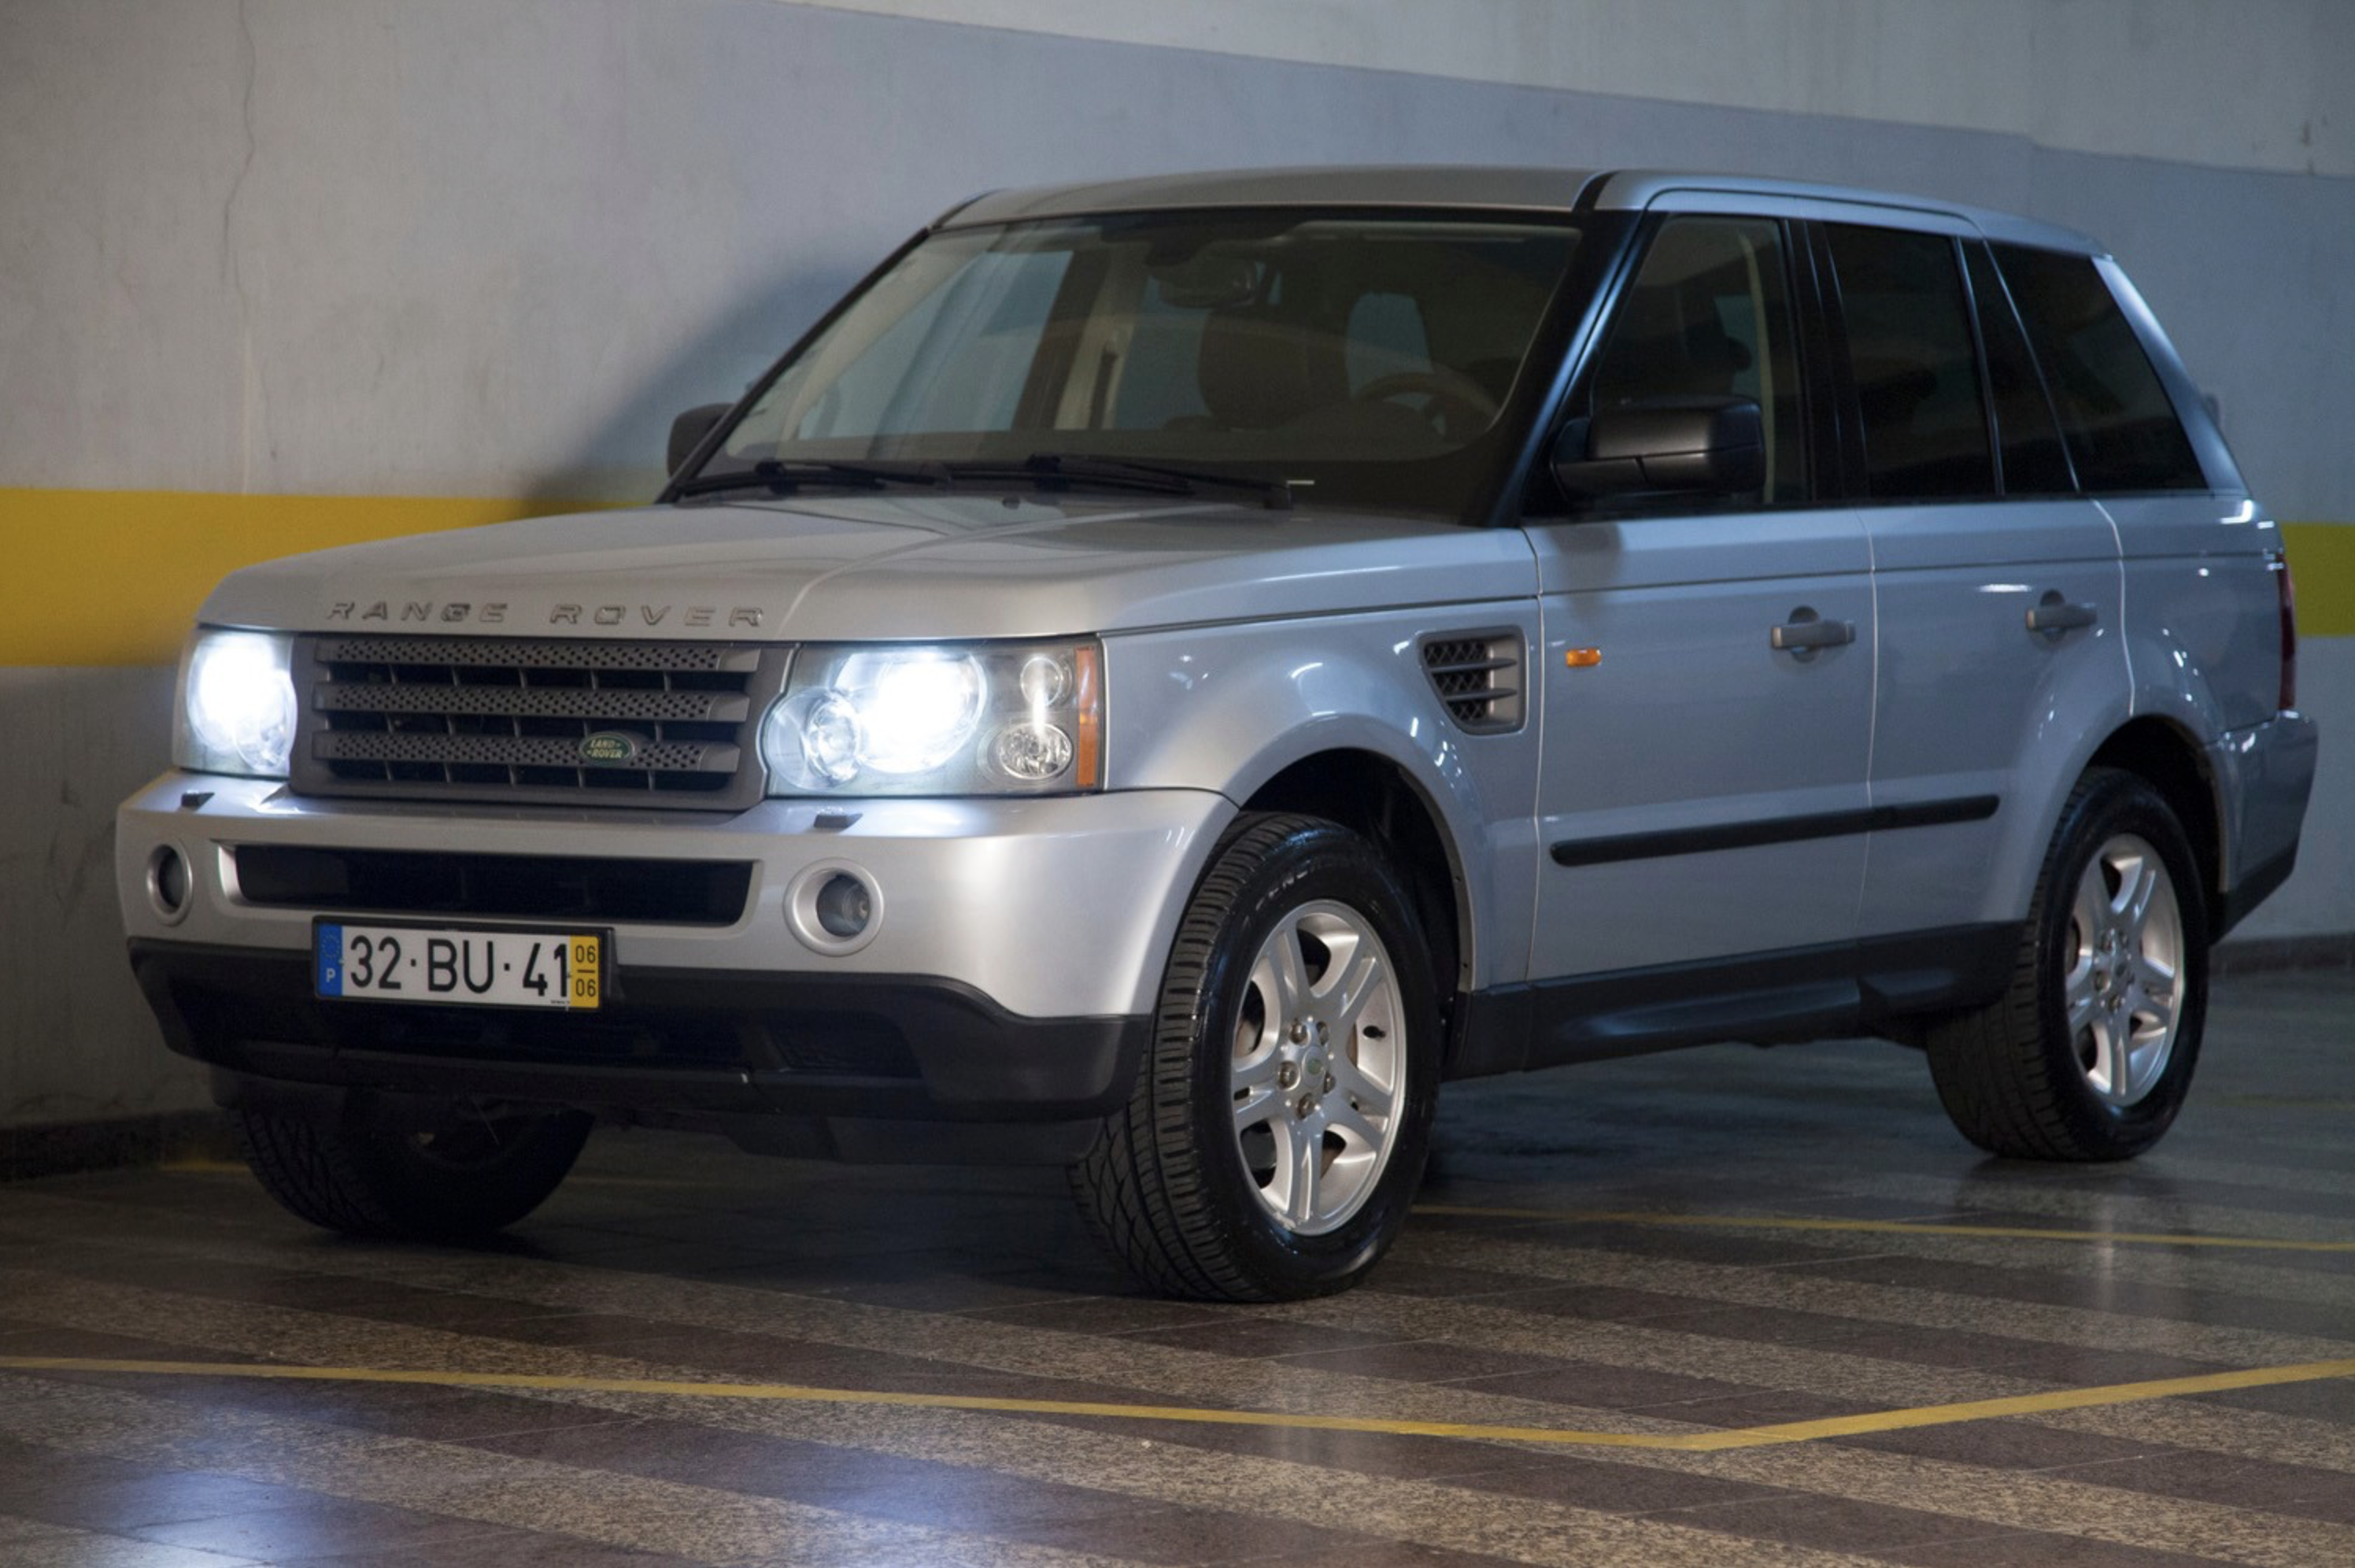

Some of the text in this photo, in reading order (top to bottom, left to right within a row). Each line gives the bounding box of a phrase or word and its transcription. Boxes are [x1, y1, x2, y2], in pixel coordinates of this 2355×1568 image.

[326, 601, 763, 627] RANGE ROVER
[590, 739, 616, 748] LAND
[591, 749, 623, 758] ROVER
[575, 944, 596, 963] 06
[326, 968, 336, 982] P
[575, 978, 597, 997] 06
